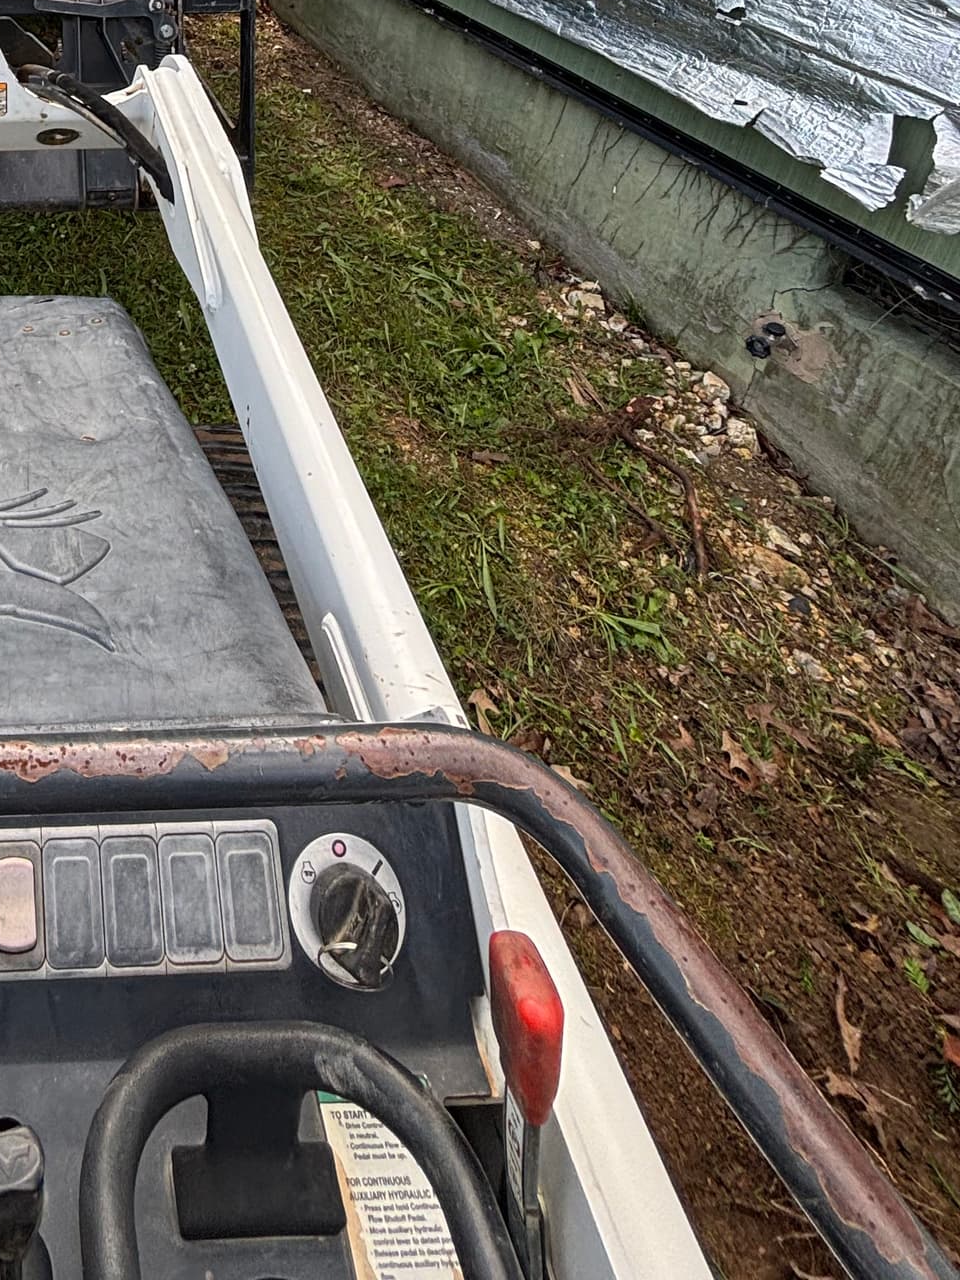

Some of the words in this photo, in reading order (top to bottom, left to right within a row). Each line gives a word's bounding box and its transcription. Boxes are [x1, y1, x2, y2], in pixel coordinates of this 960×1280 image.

[330, 1111, 342, 1120] TO
[344, 1110, 367, 1119] START
[362, 1176, 411, 1186] CONTINUOUS
[350, 1190, 386, 1200] AUXILIARY
[388, 1188, 431, 1200] HYDRAULIC
